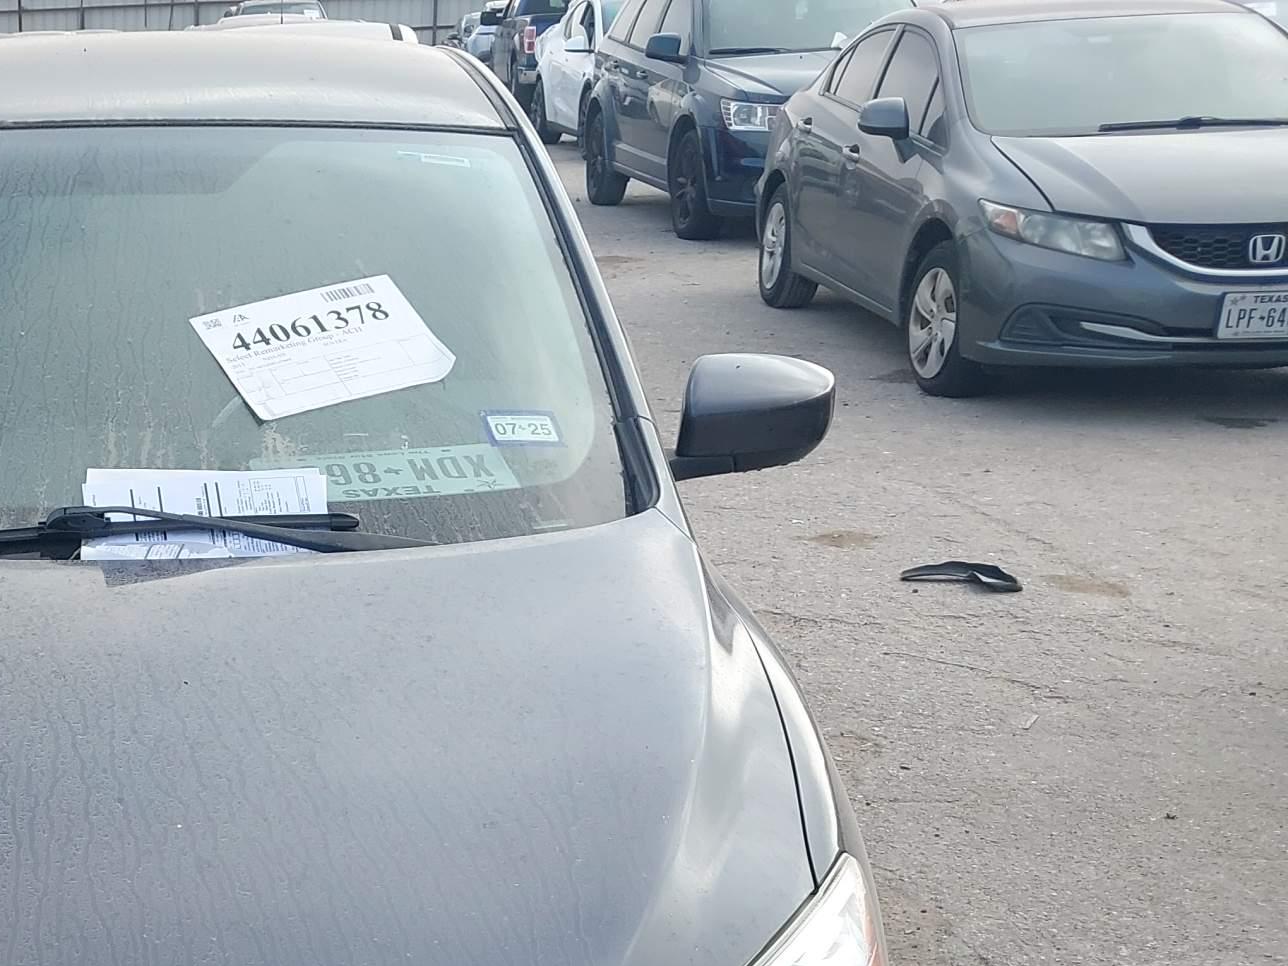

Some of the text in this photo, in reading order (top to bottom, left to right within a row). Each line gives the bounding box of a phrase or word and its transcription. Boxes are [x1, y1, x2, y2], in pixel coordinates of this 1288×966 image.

[1253, 294, 1288, 304] TEXAS
[232, 301, 390, 351] 44061378
[341, 484, 441, 499] TEXAS
